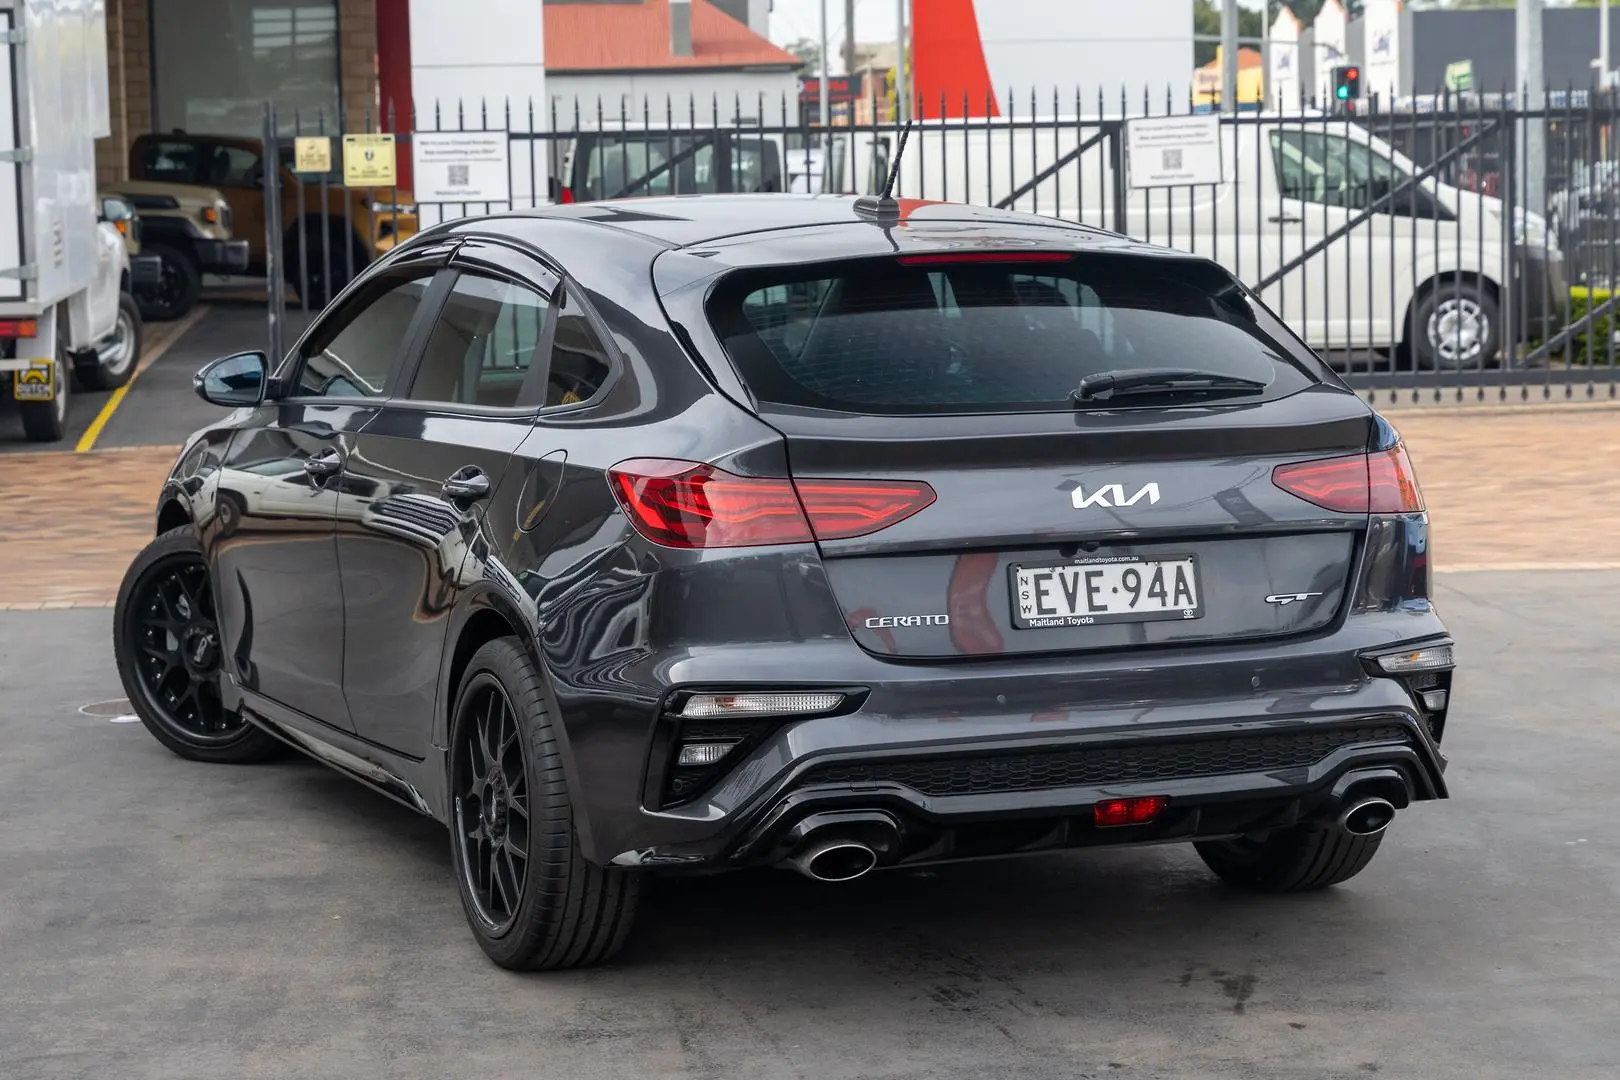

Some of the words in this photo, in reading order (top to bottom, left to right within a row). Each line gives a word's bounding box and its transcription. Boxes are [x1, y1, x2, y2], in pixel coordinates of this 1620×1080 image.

[1071, 482, 1161, 509] KIA
[1266, 592, 1323, 605] GT
[865, 614, 949, 628] CERATO
[1029, 617, 1064, 627] Maitland
[1066, 616, 1094, 626] Toyota
